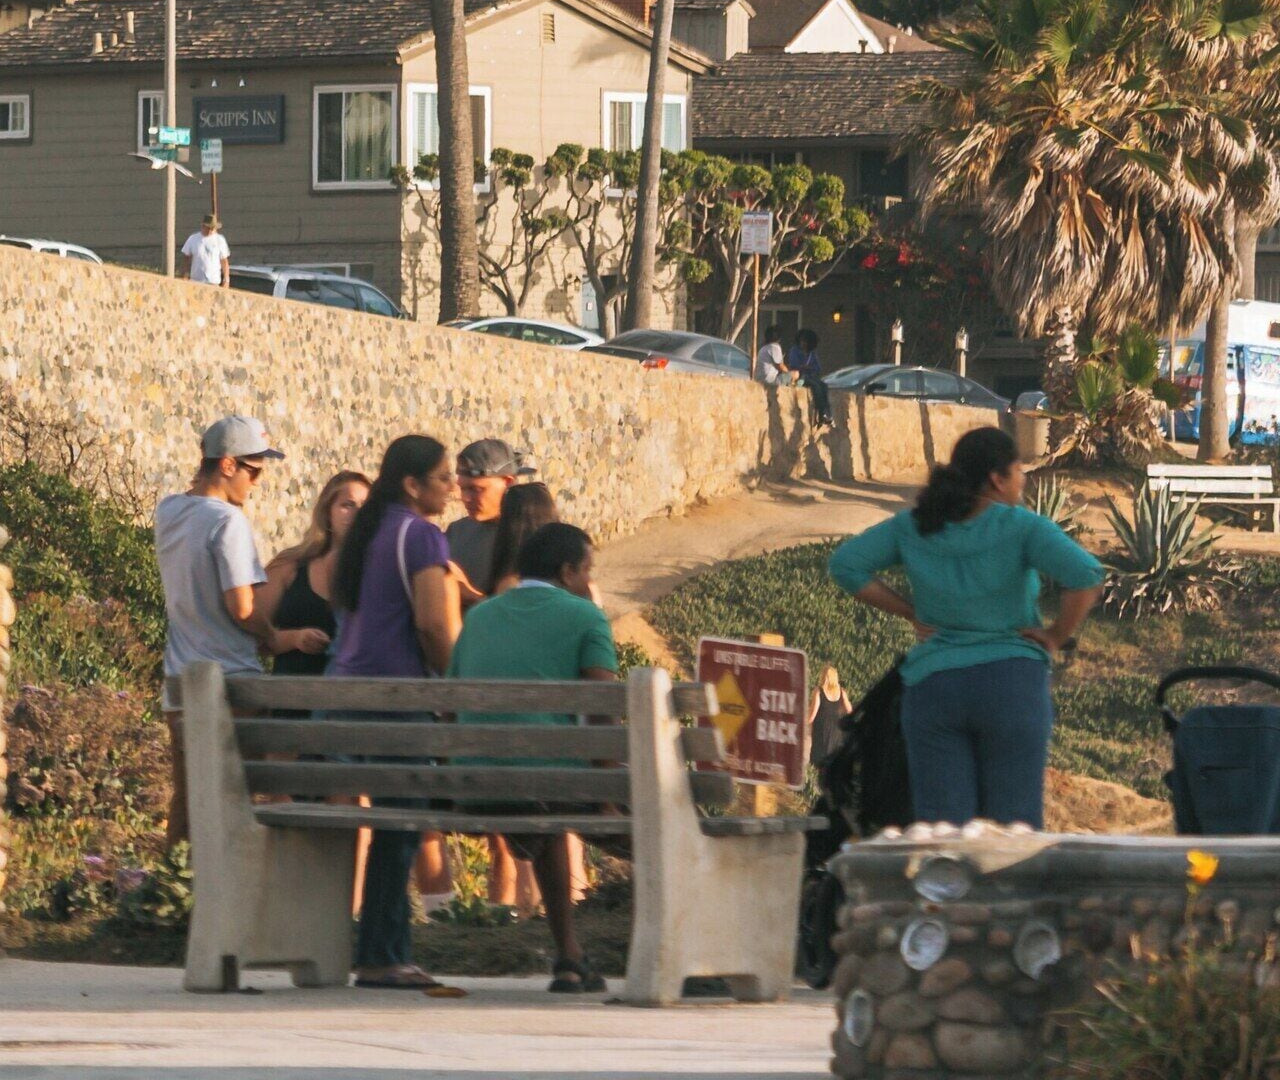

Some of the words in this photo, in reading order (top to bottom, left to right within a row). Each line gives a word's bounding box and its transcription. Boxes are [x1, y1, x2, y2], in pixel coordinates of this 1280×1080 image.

[199, 111, 249, 128] SCRIPPS
[252, 109, 277, 126] INN
[760, 689, 797, 714] STAY
[756, 719, 797, 745] BACK
